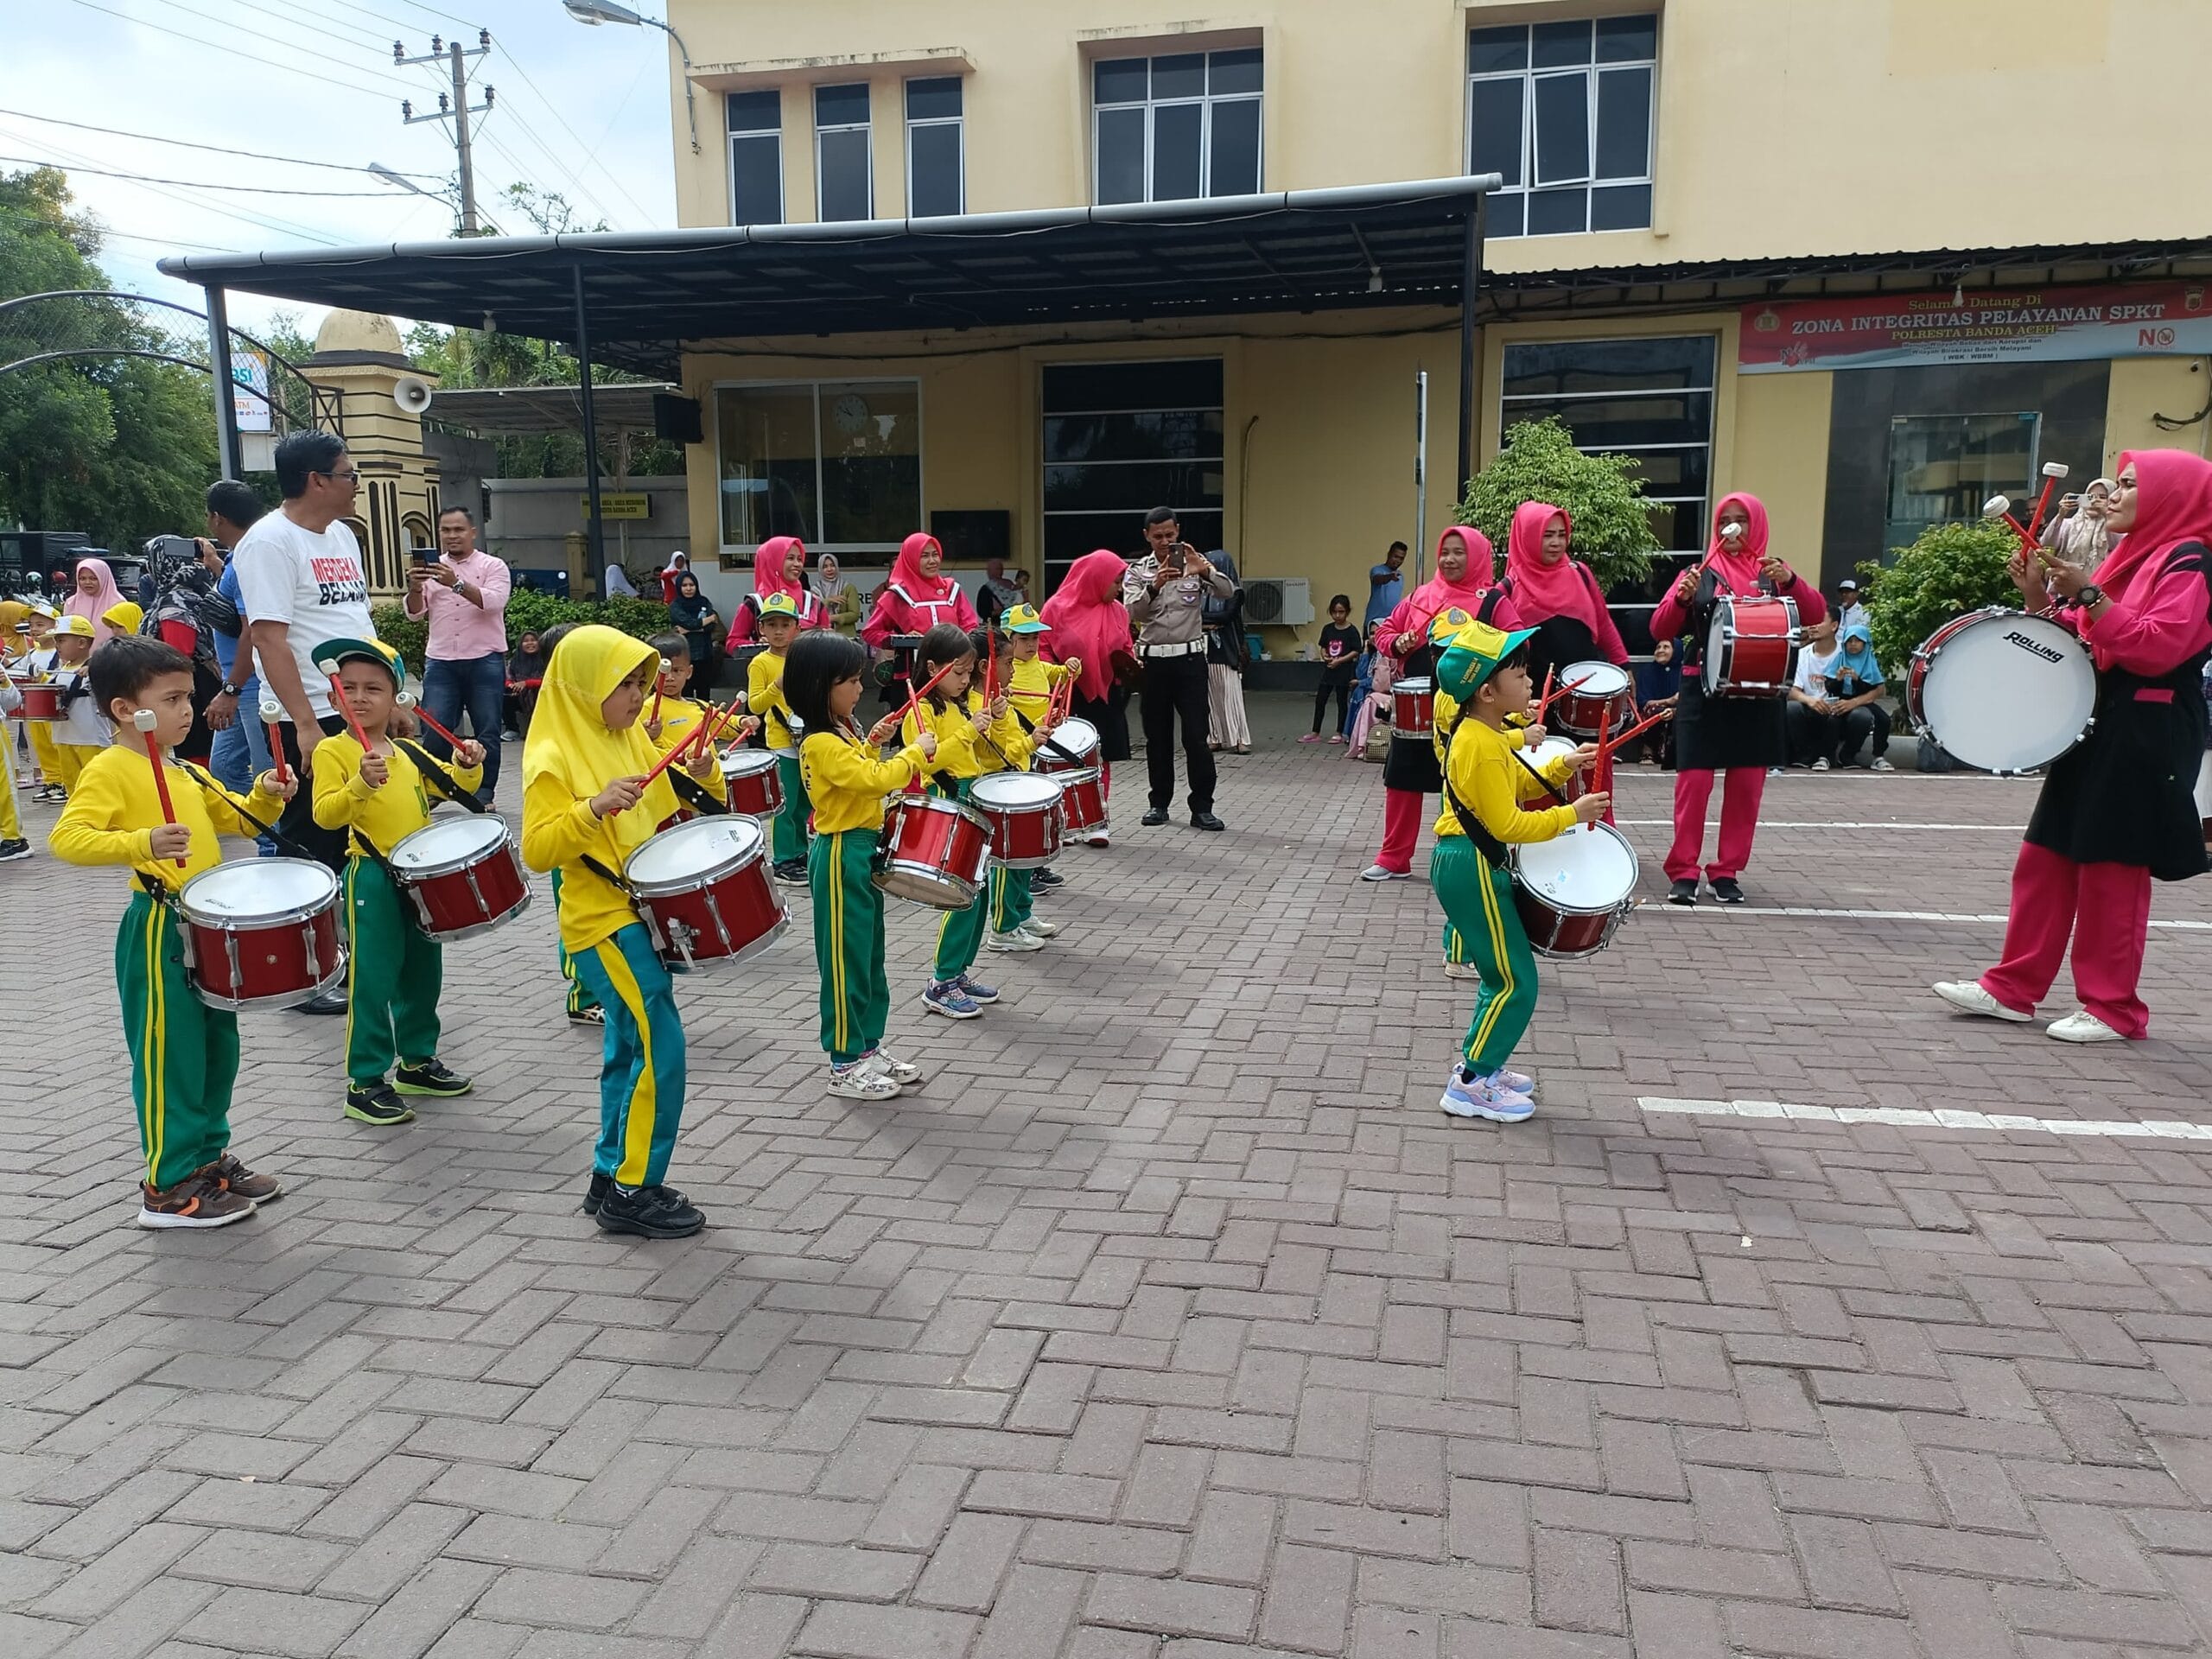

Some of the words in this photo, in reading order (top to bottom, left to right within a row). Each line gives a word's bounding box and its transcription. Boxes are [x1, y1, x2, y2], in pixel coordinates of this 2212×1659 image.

[1970, 297, 2021, 308] Datang
[2026, 295, 2041, 305] Di
[1792, 319, 1845, 334] ZONA
[1851, 311, 1973, 332] INTEGRITAS
[1980, 307, 2103, 325] PELAYANAN
[2109, 304, 2164, 320] SPKT
[1892, 327, 1961, 340] POLRESTA
[1966, 326, 2012, 337] BANDA
[2017, 324, 2056, 335] ACEH
[1999, 337, 2026, 346] Korupsi
[1999, 344, 2032, 353] Melayani
[311, 556, 360, 583] MERDEKA
[2002, 631, 2065, 664] ROLLING
